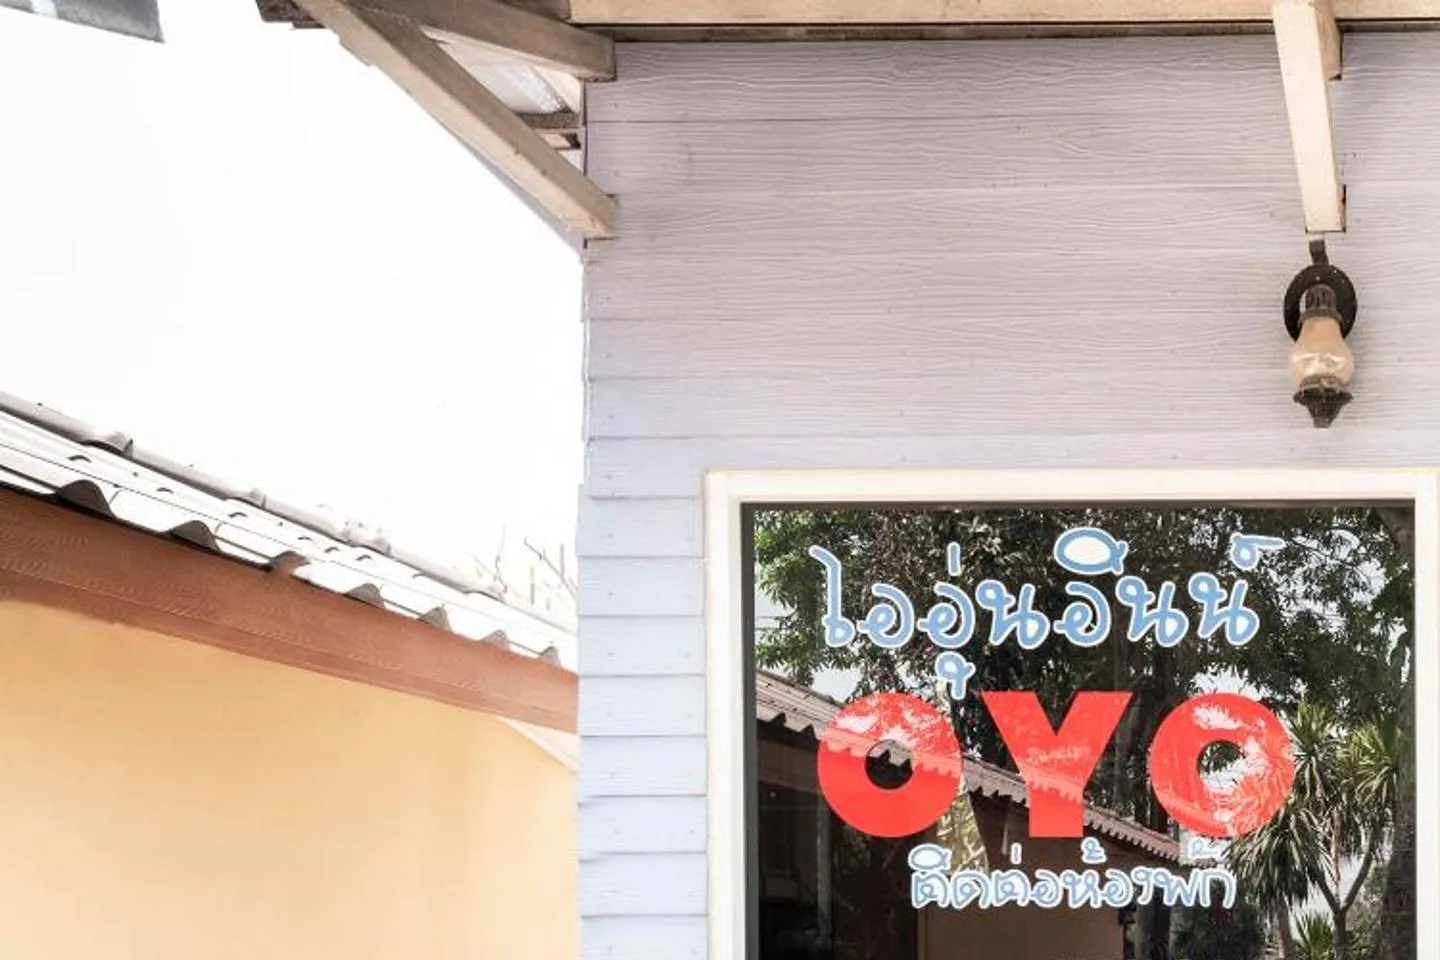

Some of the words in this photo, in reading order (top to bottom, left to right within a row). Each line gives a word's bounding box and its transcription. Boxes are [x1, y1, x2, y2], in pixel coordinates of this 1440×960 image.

[817, 691, 1297, 838] OYO
[908, 837, 1237, 909] ติดต่อห้องพัก
